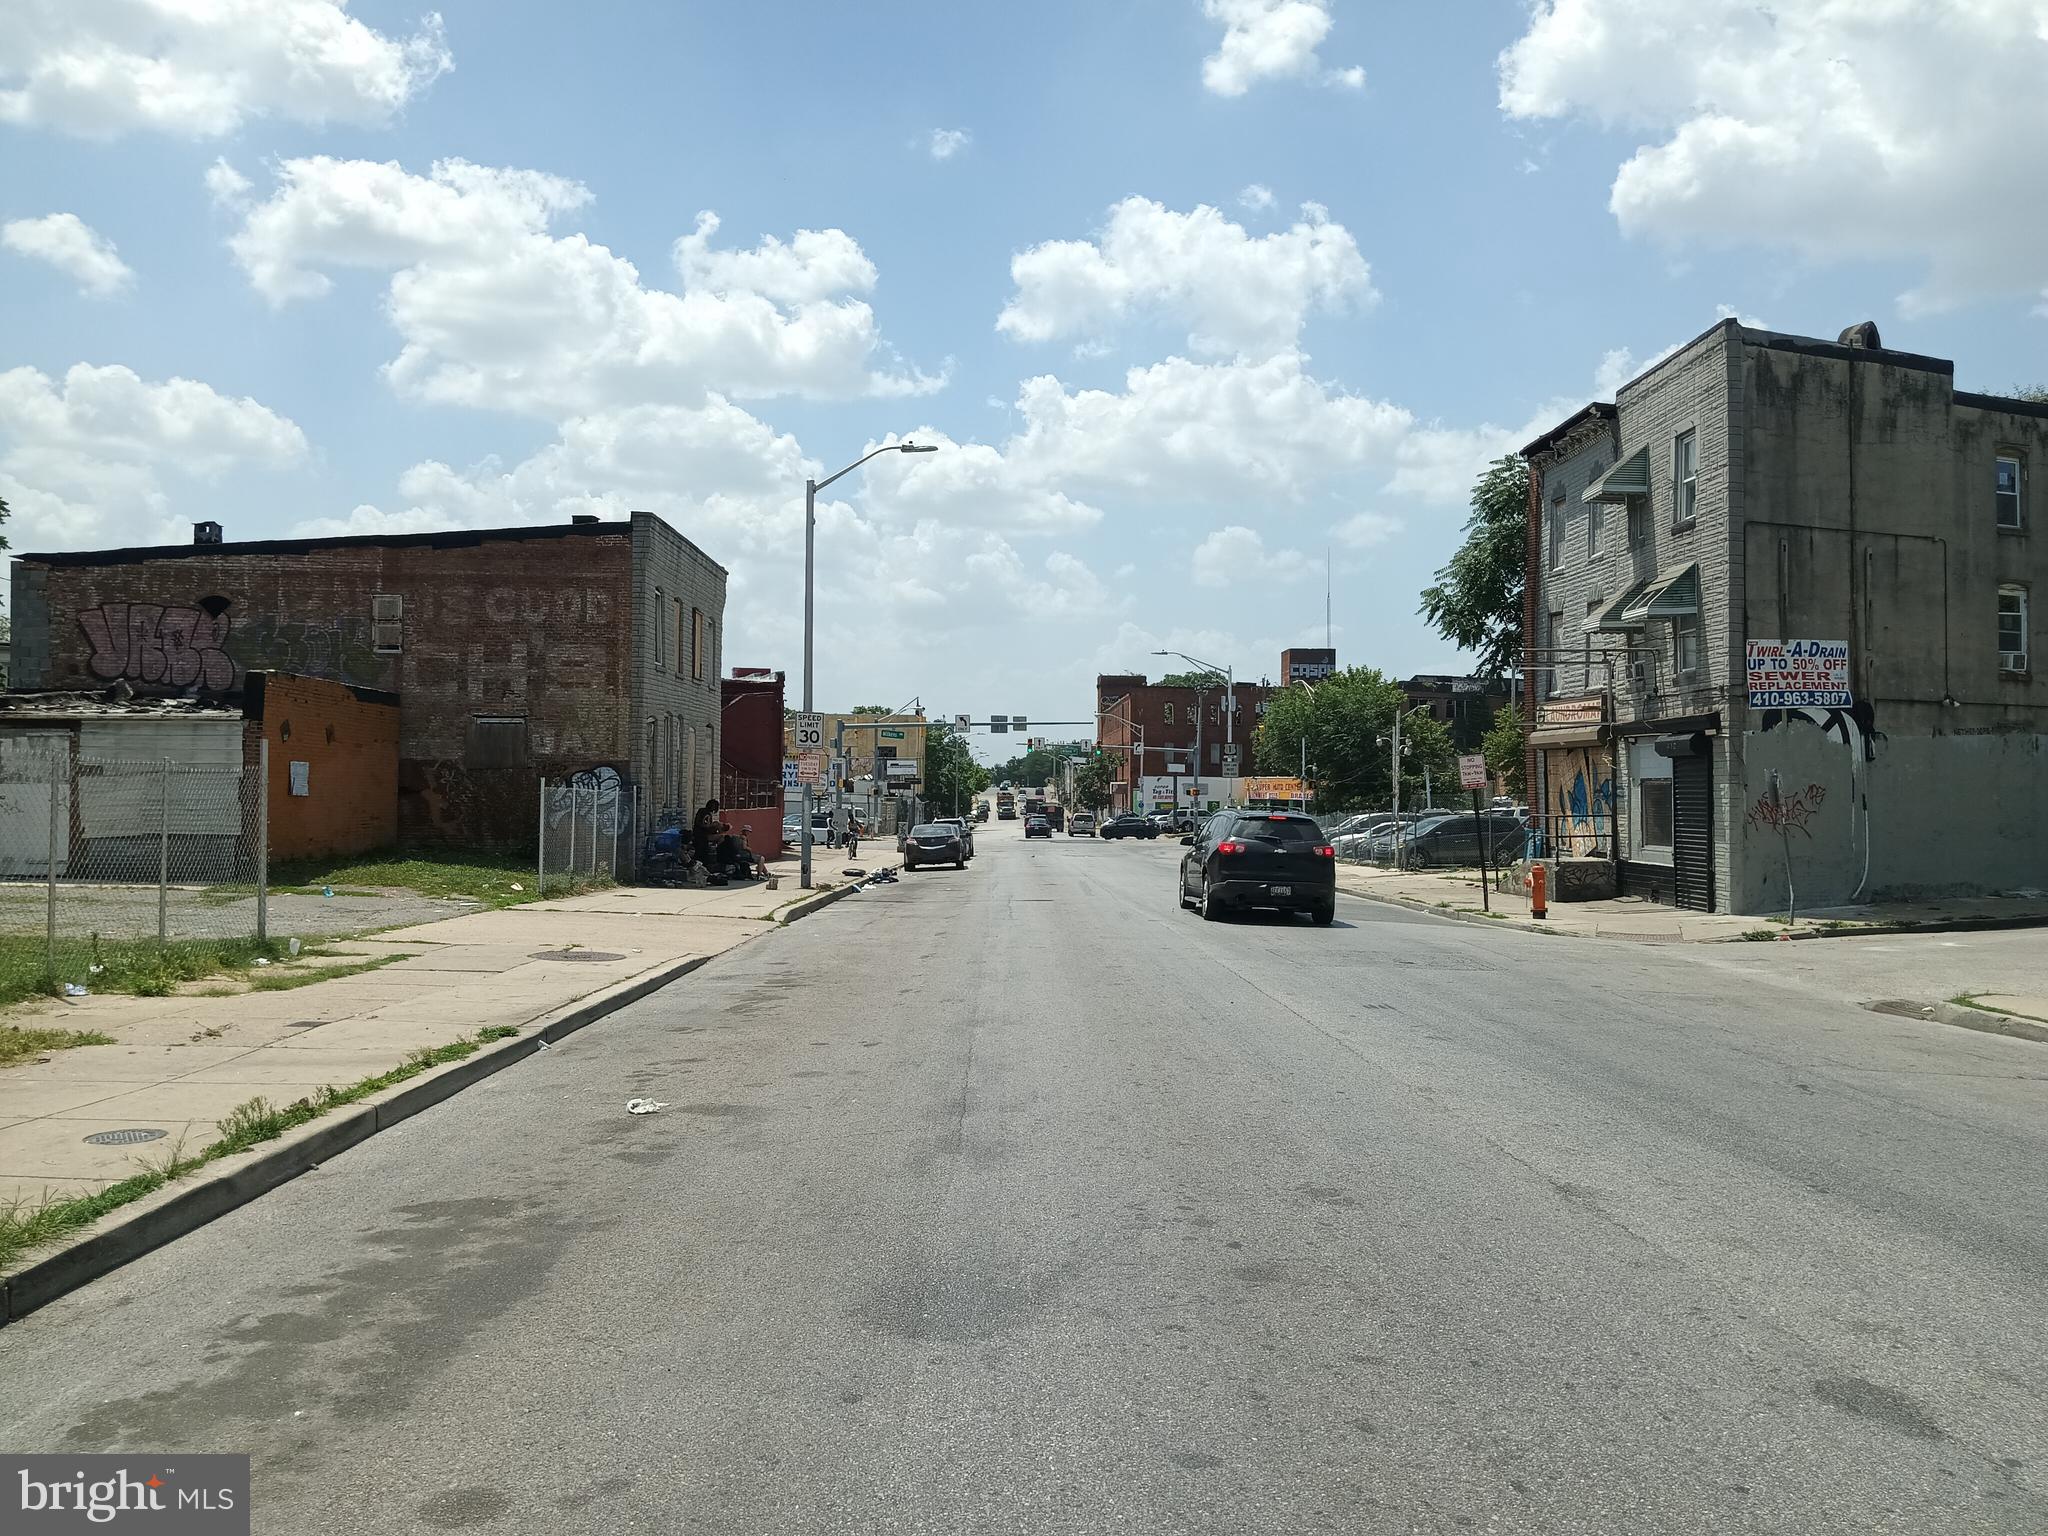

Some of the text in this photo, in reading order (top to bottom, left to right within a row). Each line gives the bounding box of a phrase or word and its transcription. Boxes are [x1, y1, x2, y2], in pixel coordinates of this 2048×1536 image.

[1748, 658, 1847, 670] UP TO 50% OFF
[1749, 671, 1831, 681] SEWER
[1749, 681, 1847, 690] REPLACEMENT
[1752, 692, 1847, 706] 410-963-5807
[799, 729, 820, 743] 30
